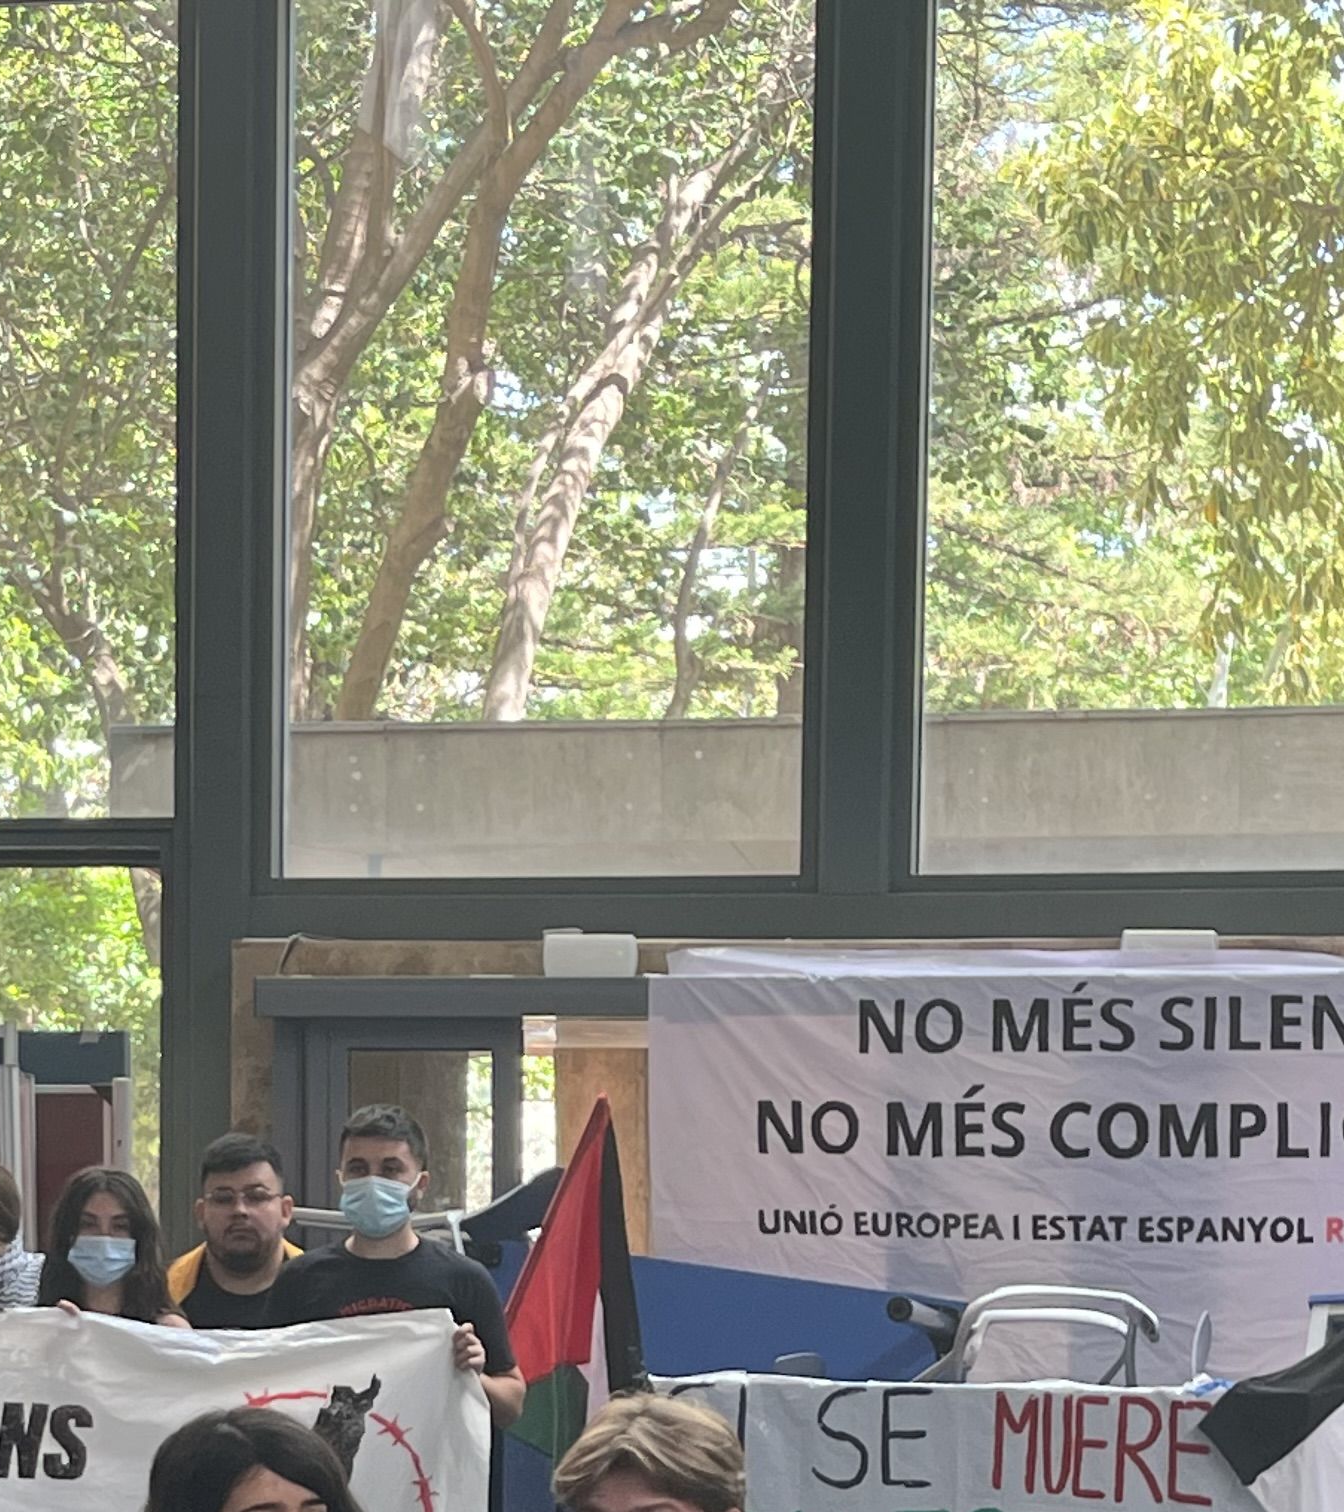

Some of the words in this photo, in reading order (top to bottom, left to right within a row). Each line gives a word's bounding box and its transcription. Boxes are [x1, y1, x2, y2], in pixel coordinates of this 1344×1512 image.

[859, 998, 965, 1054] NO
[992, 982, 1136, 1053] MÉS
[758, 1101, 859, 1155] NO
[887, 1085, 1027, 1158] MÉS
[759, 1204, 844, 1236] UNIÓ
[855, 1212, 1004, 1241] EUROPEA
[1013, 1215, 1022, 1242] I
[1032, 1215, 1129, 1243] ESTAT
[1139, 1216, 1315, 1245] ESPANYOL
[811, 1386, 934, 1490] SE
[991, 1390, 1214, 1506] MUERE
